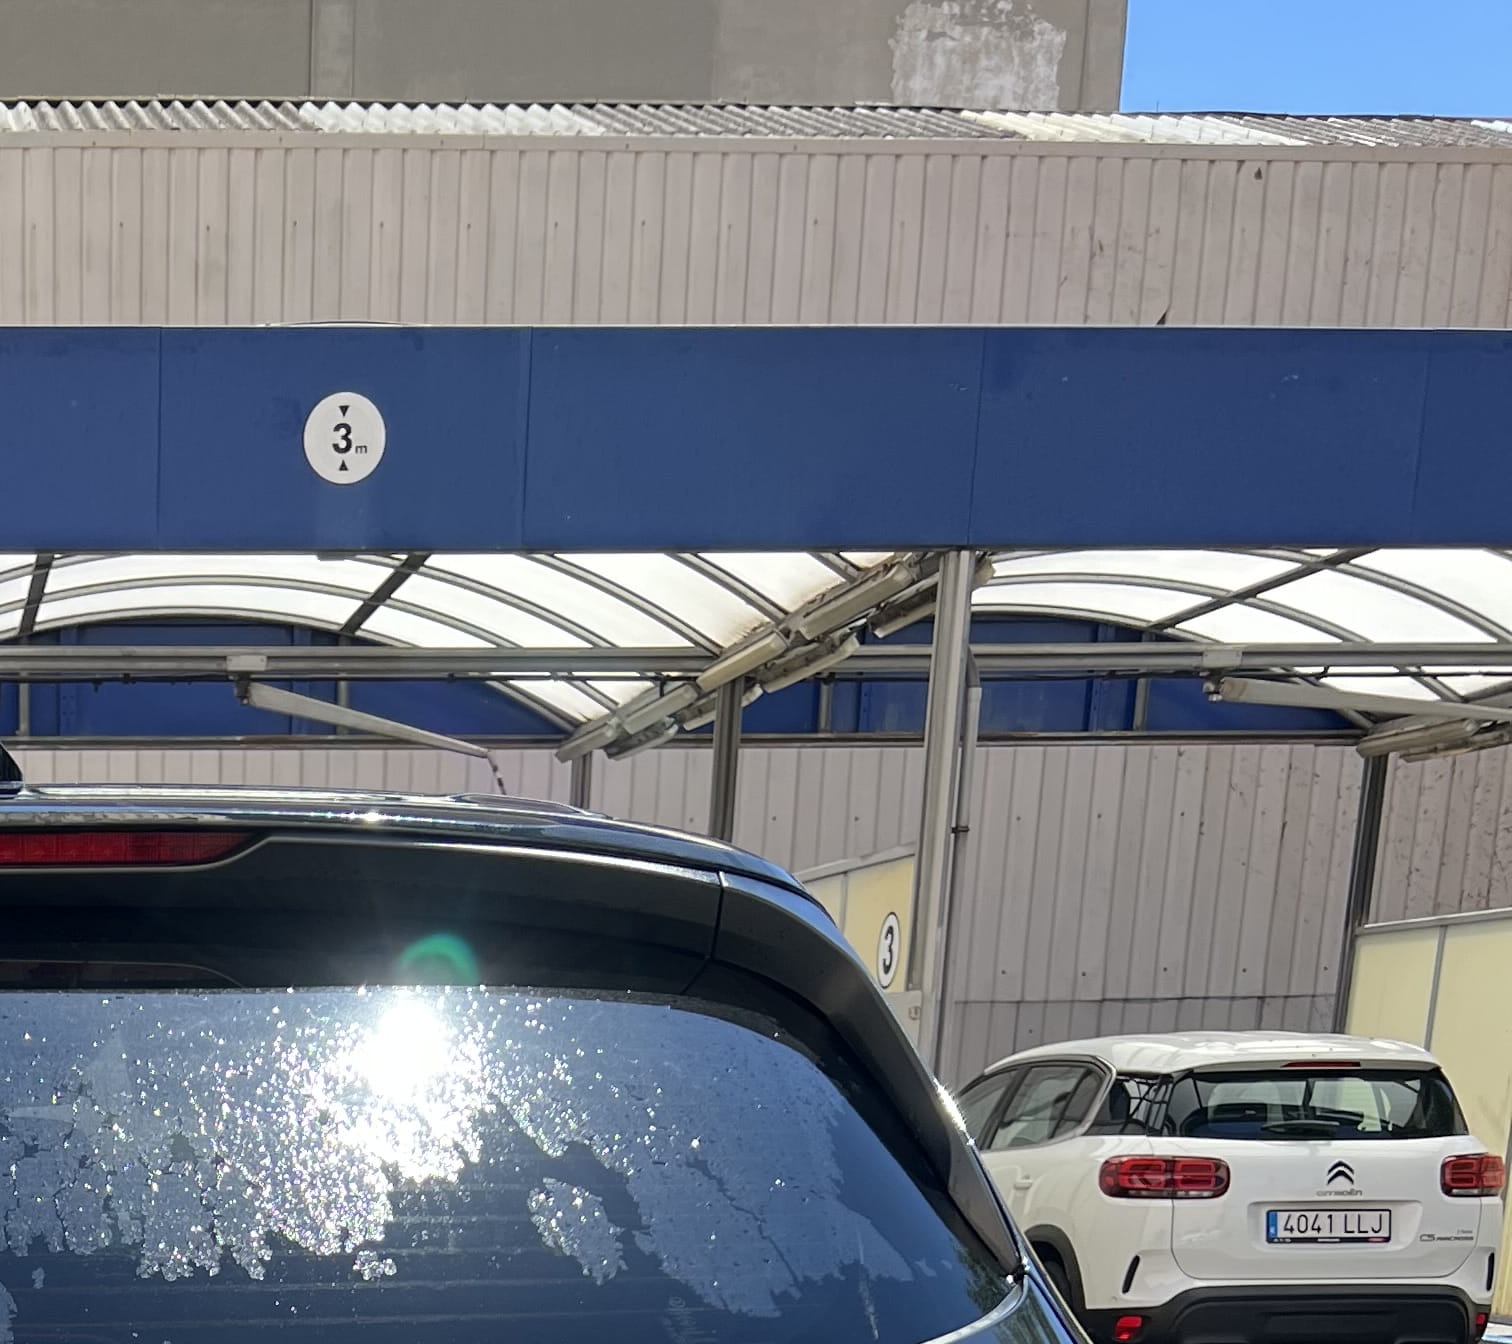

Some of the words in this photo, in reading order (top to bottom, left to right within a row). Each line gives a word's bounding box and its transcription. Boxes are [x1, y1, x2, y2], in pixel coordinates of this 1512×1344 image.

[882, 925, 894, 975] 3
[1283, 1214, 1334, 1234] 4041
[1344, 1214, 1383, 1234] LLJ
